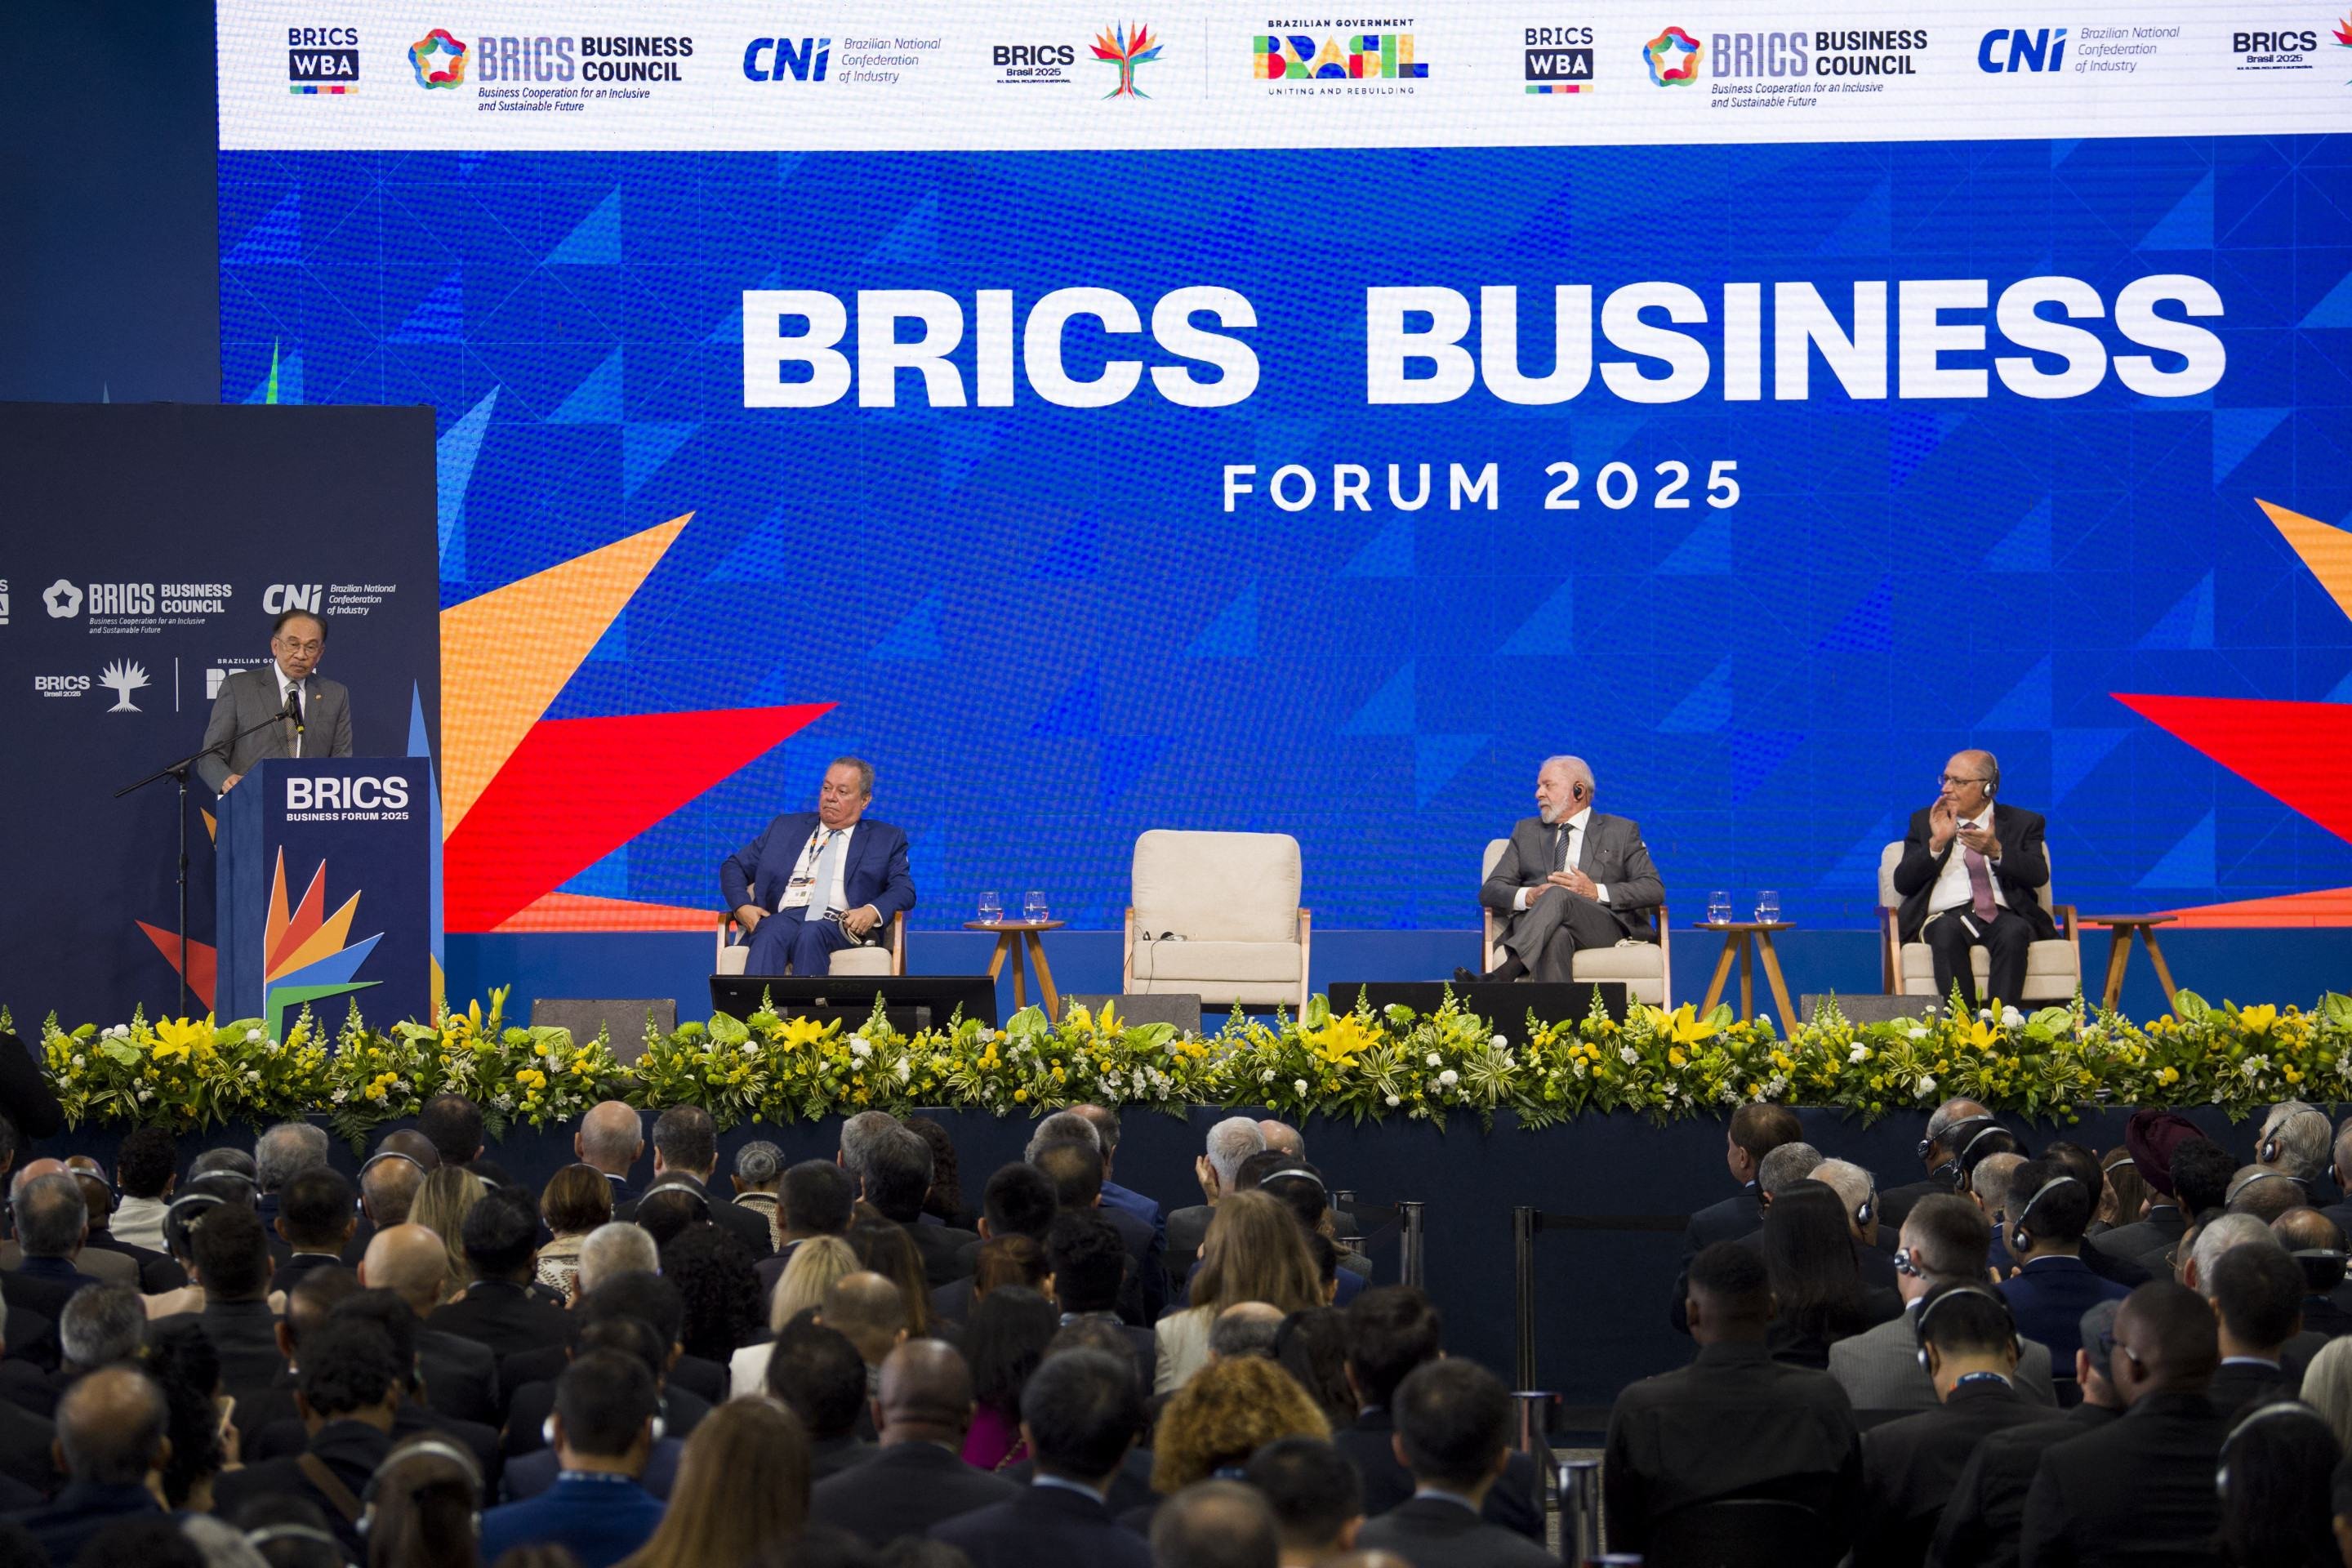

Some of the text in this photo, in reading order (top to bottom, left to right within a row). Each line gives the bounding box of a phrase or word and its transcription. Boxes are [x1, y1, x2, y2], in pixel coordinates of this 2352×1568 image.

[1336, 19, 1414, 27] GOVERNMENT
[289, 28, 358, 46] BRICS
[1526, 27, 1592, 45] BRICS
[2081, 26, 2180, 38] Brazilian National
[581, 37, 693, 56] BUSINESS
[844, 38, 941, 49] Brazilian National
[1816, 29, 1927, 51] BUSINESS
[2234, 31, 2317, 52] BRICS
[994, 46, 1074, 65] BRICS
[1713, 33, 1808, 78] BRICS
[2078, 43, 2157, 57] Confederation
[294, 56, 353, 74] WBA
[479, 37, 575, 82] BRICS
[842, 54, 919, 68] Confederation
[1530, 55, 1588, 74] WBA
[1816, 56, 1916, 75] COUNCIL
[582, 61, 682, 82] COUNCIL
[1035, 68, 1061, 76] 2025
[2075, 60, 2136, 74] of Industry
[840, 70, 899, 83] of Industry
[479, 87, 519, 98] Business
[523, 88, 578, 100] Cooperation
[581, 87, 594, 97] for
[609, 88, 650, 98] Inclusive
[1712, 84, 1753, 94] Business
[1756, 82, 1811, 95] Cooperation
[1814, 82, 1827, 92] for
[1842, 82, 1883, 92] Inclusive
[479, 100, 584, 111] and Sustainable Future
[1712, 96, 1816, 107] and Sustainable Future
[743, 274, 2226, 408] BRICS BUSINESS
[1224, 461, 1740, 512] FORUM 2025
[162, 584, 232, 597] BUSINESS
[89, 583, 154, 614] BRICS
[329, 595, 381, 604] Confederation
[162, 600, 225, 612] COUNCIL
[327, 606, 369, 615] of Industry
[119, 617, 157, 626] Cooperation
[35, 675, 90, 690] BRICS
[287, 777, 408, 808] BRICS
[381, 812, 408, 820] 2025
